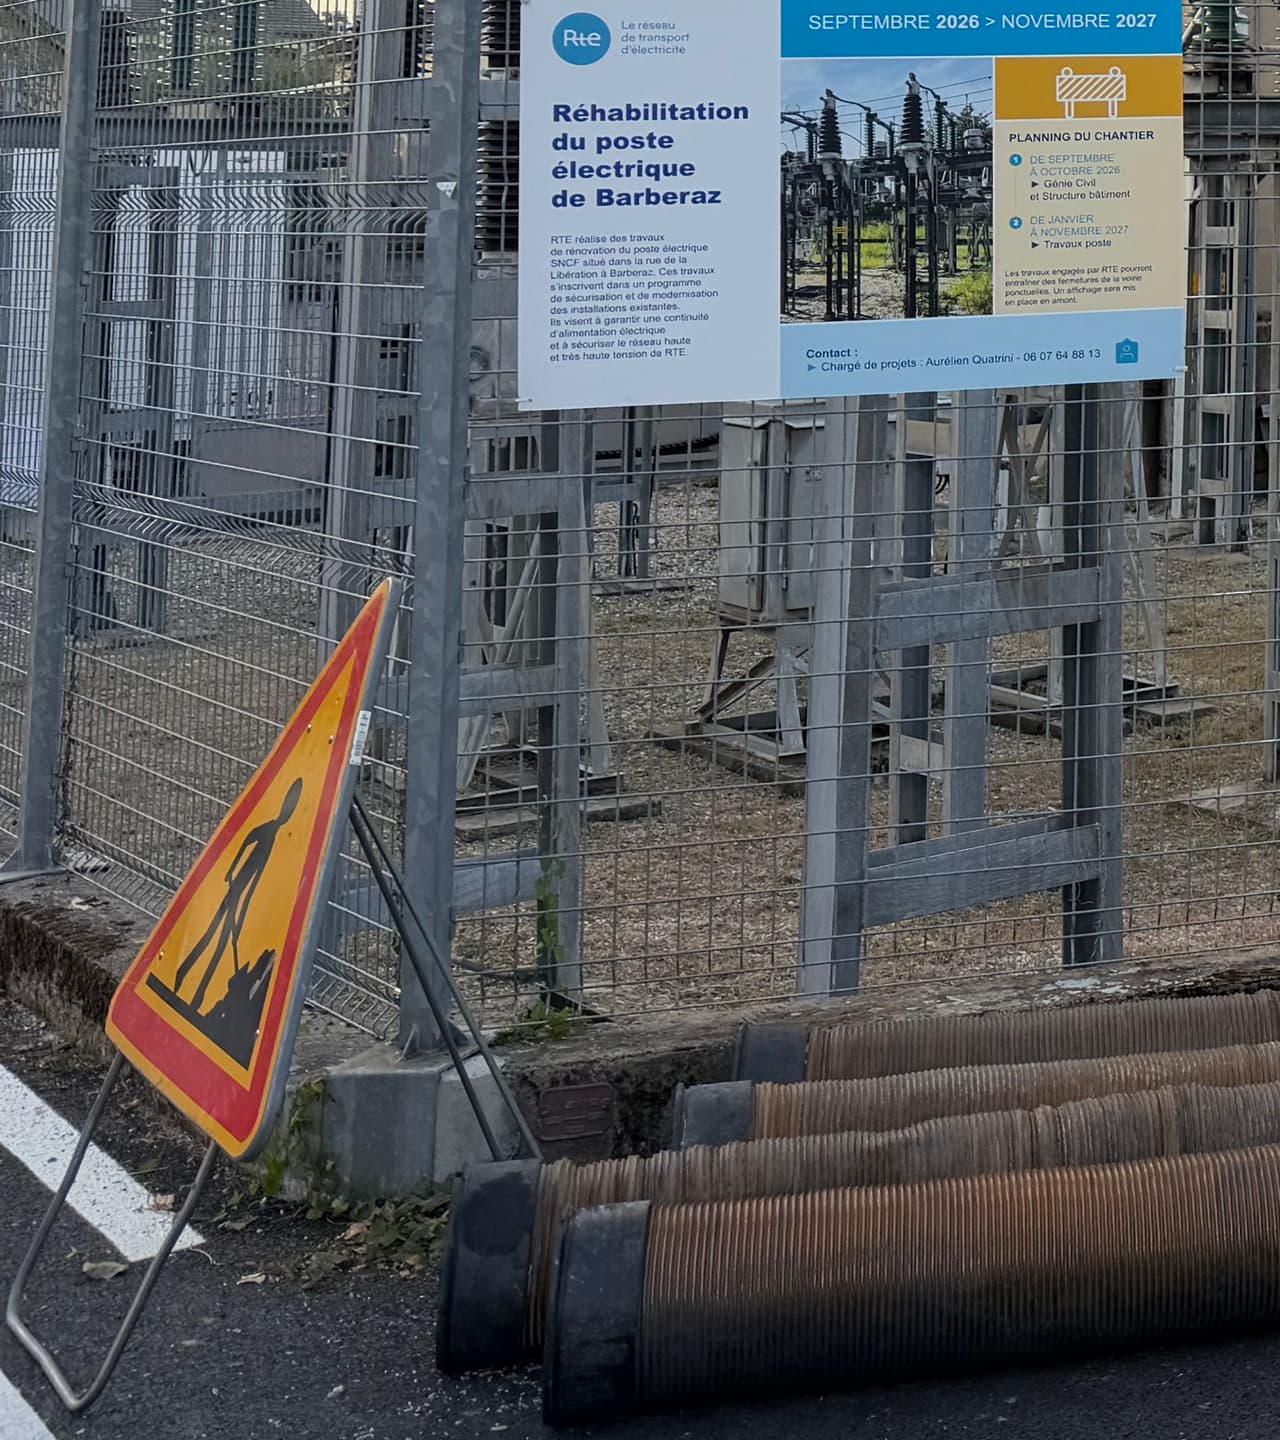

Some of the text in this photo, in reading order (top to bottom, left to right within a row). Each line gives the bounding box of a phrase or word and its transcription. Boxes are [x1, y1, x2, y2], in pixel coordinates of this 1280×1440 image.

[622, 21, 675, 29] Le réseau
[809, 15, 930, 30] SEPTEMBRE
[936, 15, 979, 29] 2026
[1002, 13, 1110, 29] NOVEMBRE
[1116, 14, 1155, 28] 2027
[563, 29, 601, 46] Rte
[622, 33, 689, 43] de transport
[622, 46, 685, 54] d'électricité
[553, 102, 748, 122] Réhabilitation
[1009, 131, 1154, 143] PLANNING DU CHANTIER
[552, 132, 674, 154] du poste
[1030, 155, 1044, 164] DE
[1048, 154, 1114, 164] SEPTEMBRE
[552, 160, 695, 181] électrique
[1030, 166, 1120, 176] À OCTOBRE 2026
[1044, 179, 1095, 188] Génie Civil
[552, 188, 721, 207] de Barberaz
[1030, 190, 1130, 201] et Structure bâtiment
[1030, 216, 1044, 225] DE
[1048, 215, 1094, 224] JANVIER
[1030, 225, 1128, 237] À NOVEMBRE 2027
[551, 236, 572, 244] RTE
[575, 235, 606, 243] réalise
[610, 234, 627, 242] des
[1044, 239, 1111, 249] Travaux poste
[566, 246, 615, 254] rénovation
[619, 246, 630, 254] du
[634, 246, 659, 255] poste
[663, 244, 708, 253] électrique
[551, 259, 579, 267] SNCF
[635, 257, 642, 265] la
[551, 270, 597, 279] Libération
[601, 270, 606, 278] à
[610, 269, 655, 277] Barberaz.
[659, 268, 677, 276] Ces
[1052, 268, 1085, 276] engagés
[1121, 265, 1152, 273] pourront
[551, 282, 604, 291] s'inscrivent
[607, 281, 630, 289] dans
[648, 279, 701, 289] programme
[551, 295, 562, 303] de
[566, 293, 622, 302] sécurisation
[652, 290, 718, 299] modernisation
[1006, 288, 1050, 297] ponctuelles.
[1067, 286, 1102, 295] affichage
[1017, 298, 1038, 306] place
[571, 304, 626, 314] installations
[630, 303, 680, 311] existantes.
[564, 317, 592, 325] visent
[596, 316, 601, 324] à
[604, 316, 640, 326] garantir
[664, 313, 709, 322] continuité
[551, 327, 665, 338] d'alimentation électrique
[550, 337, 690, 350] et à sécuriser le réseau haute
[562, 353, 580, 361] très
[583, 352, 609, 360] haute
[613, 350, 647, 359] tension
[650, 349, 661, 357] de
[665, 348, 688, 356] RTE.
[806, 349, 850, 358] Contact
[822, 361, 861, 372] Chargé
[864, 361, 877, 370] de
[881, 359, 917, 371] projets
[926, 356, 969, 367] Aurélien
[972, 353, 1013, 366] Quatrini
[1024, 352, 1036, 362] 06
[1040, 352, 1053, 361] 07
[1056, 351, 1068, 360] 64
[1072, 350, 1085, 359] 88
[1089, 349, 1100, 358] 13
